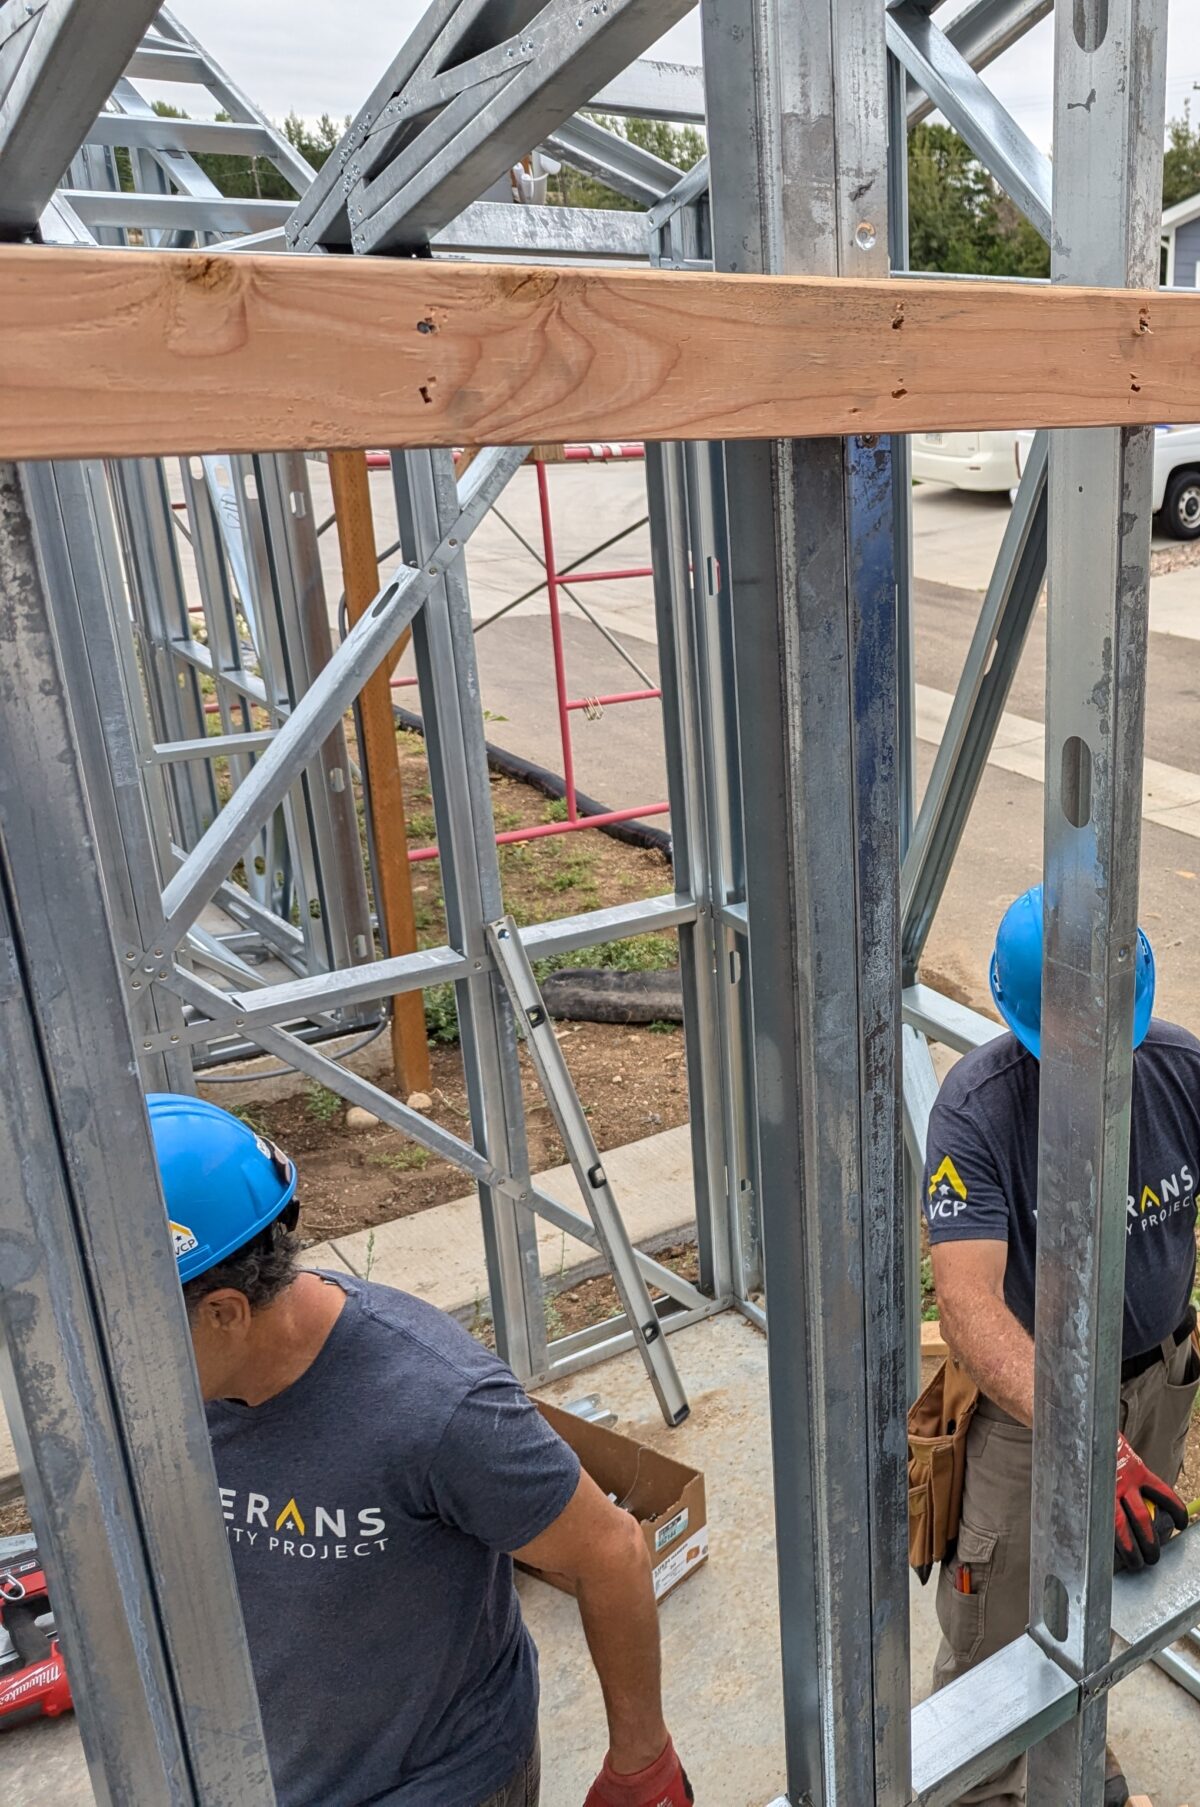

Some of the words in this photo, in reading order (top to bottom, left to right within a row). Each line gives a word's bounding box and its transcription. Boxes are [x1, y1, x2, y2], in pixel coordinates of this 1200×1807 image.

[929, 1199, 968, 1220] VCP
[1141, 1194, 1192, 1232] PROJEC
[269, 1537, 389, 1560] PROJECT
